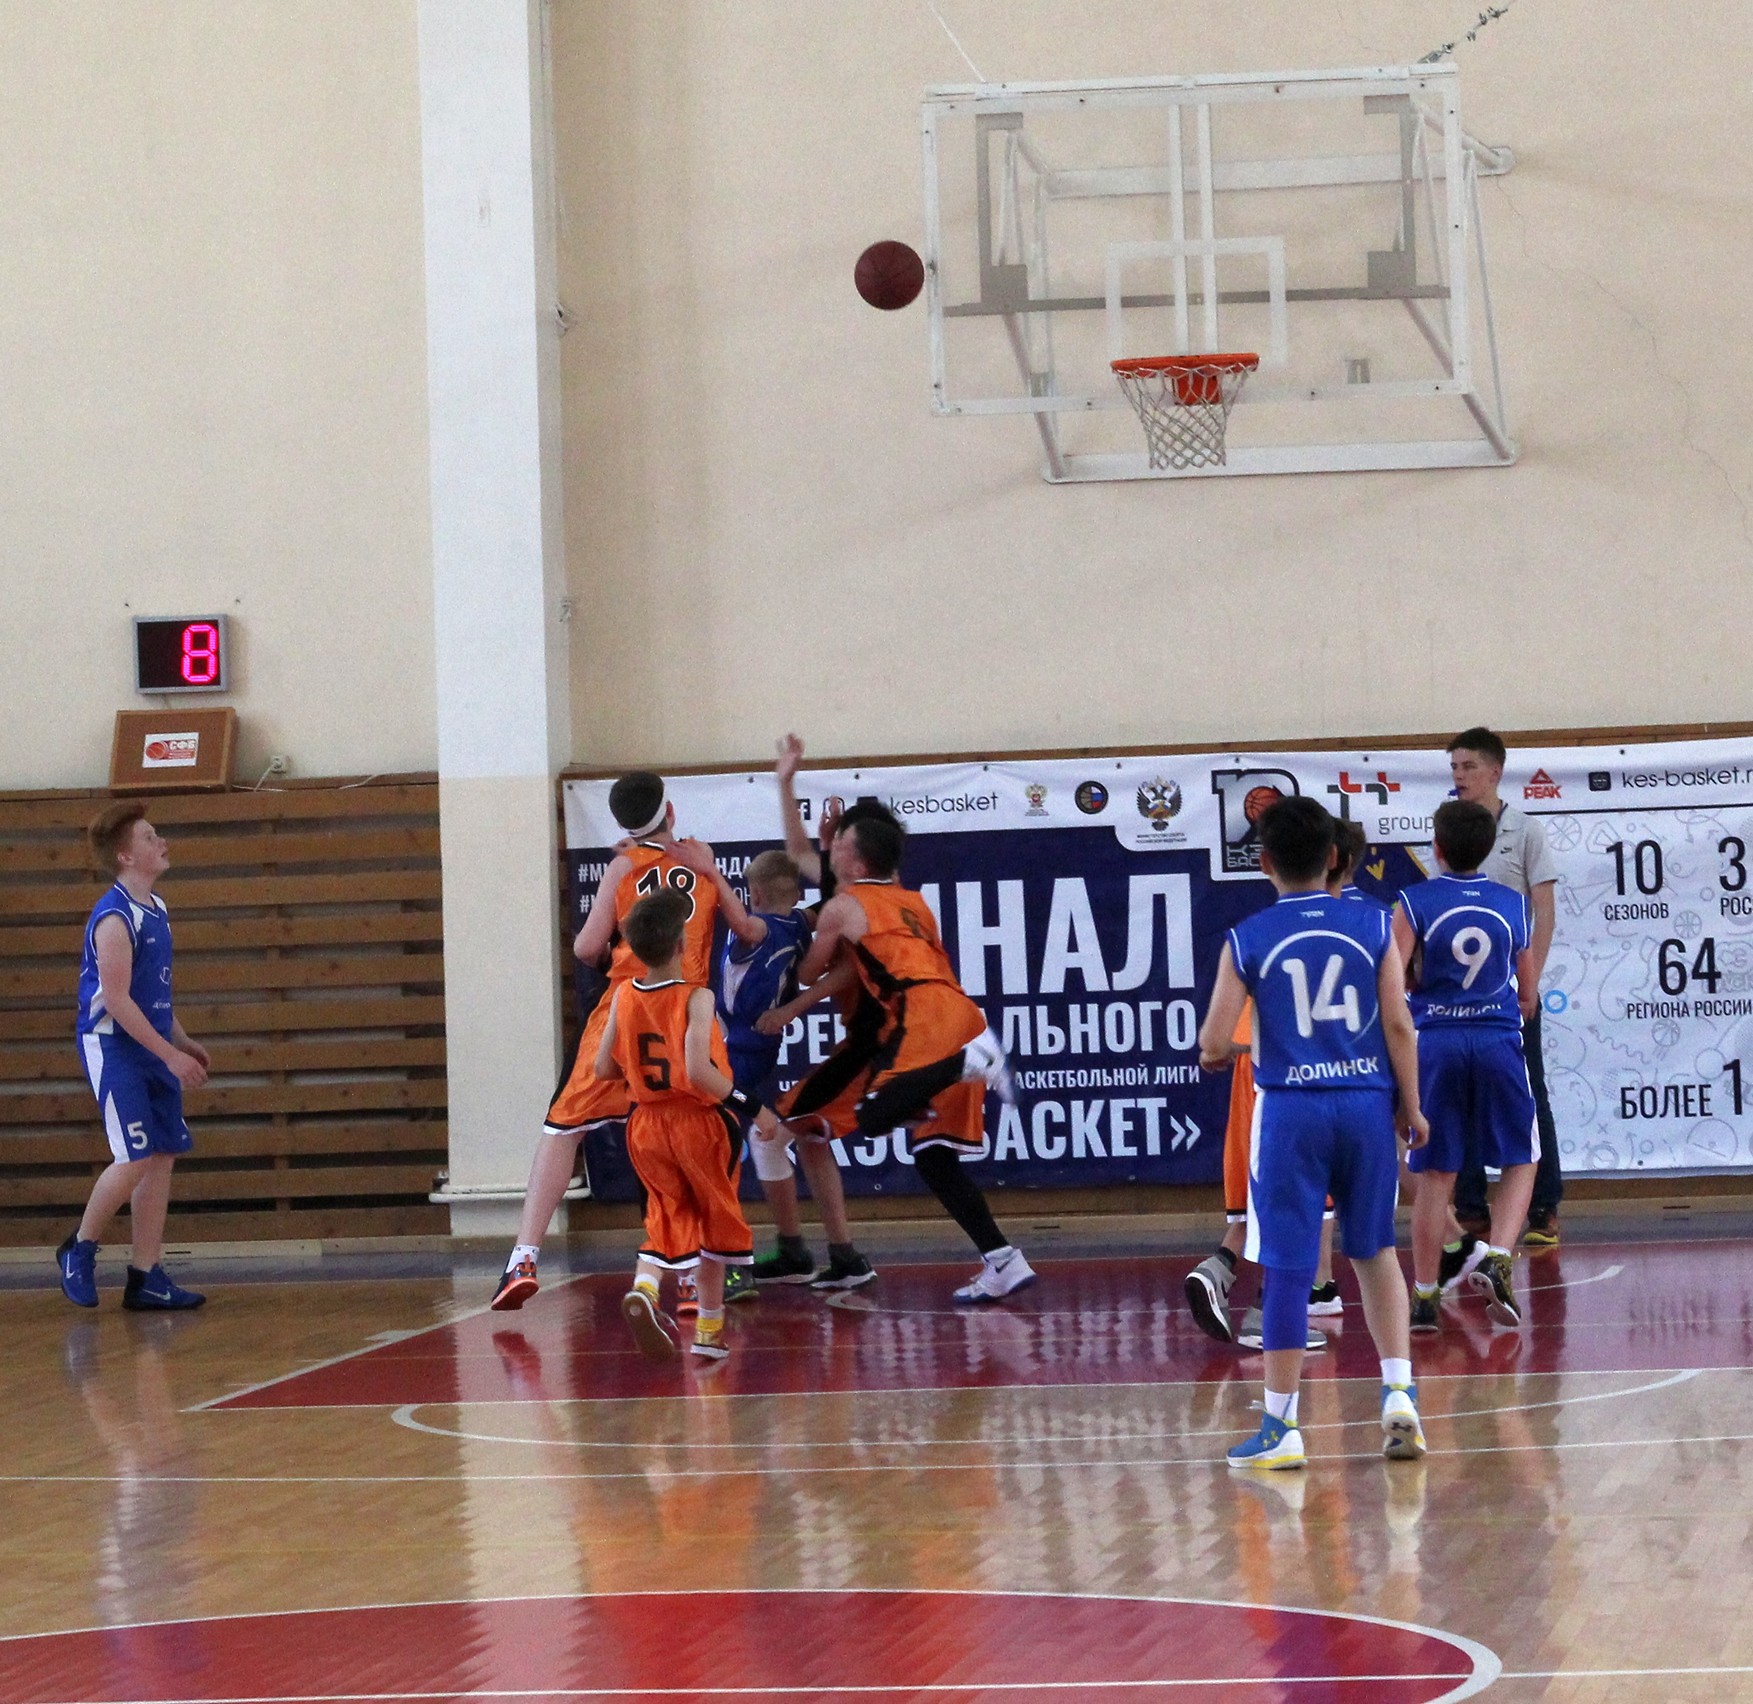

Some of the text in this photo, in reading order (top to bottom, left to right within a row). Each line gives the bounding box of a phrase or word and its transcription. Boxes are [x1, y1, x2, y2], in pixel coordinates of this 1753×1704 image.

[182, 624, 218, 683] 8
[889, 792, 998, 815] kesbasket
[1523, 785, 1562, 799] PEAK
[1606, 839, 1664, 896] 10
[1718, 836, 1747, 892] 3
[1604, 903, 1669, 921] СЕЗОНОВ
[1451, 926, 1492, 990] 9
[1658, 937, 1722, 996] 64
[1281, 953, 1361, 1039] 14
[1627, 999, 1752, 1020] РЕГИОНА РОССИИ
[637, 1032, 672, 1091] 5
[1014, 1063, 1200, 1090] АСКЕТБОЛЬНОЙ ЛИГИ
[1285, 1056, 1379, 1085] ДОЛИНСК
[1620, 1084, 1713, 1119] БОЛЕЕ
[127, 1121, 148, 1150] 5
